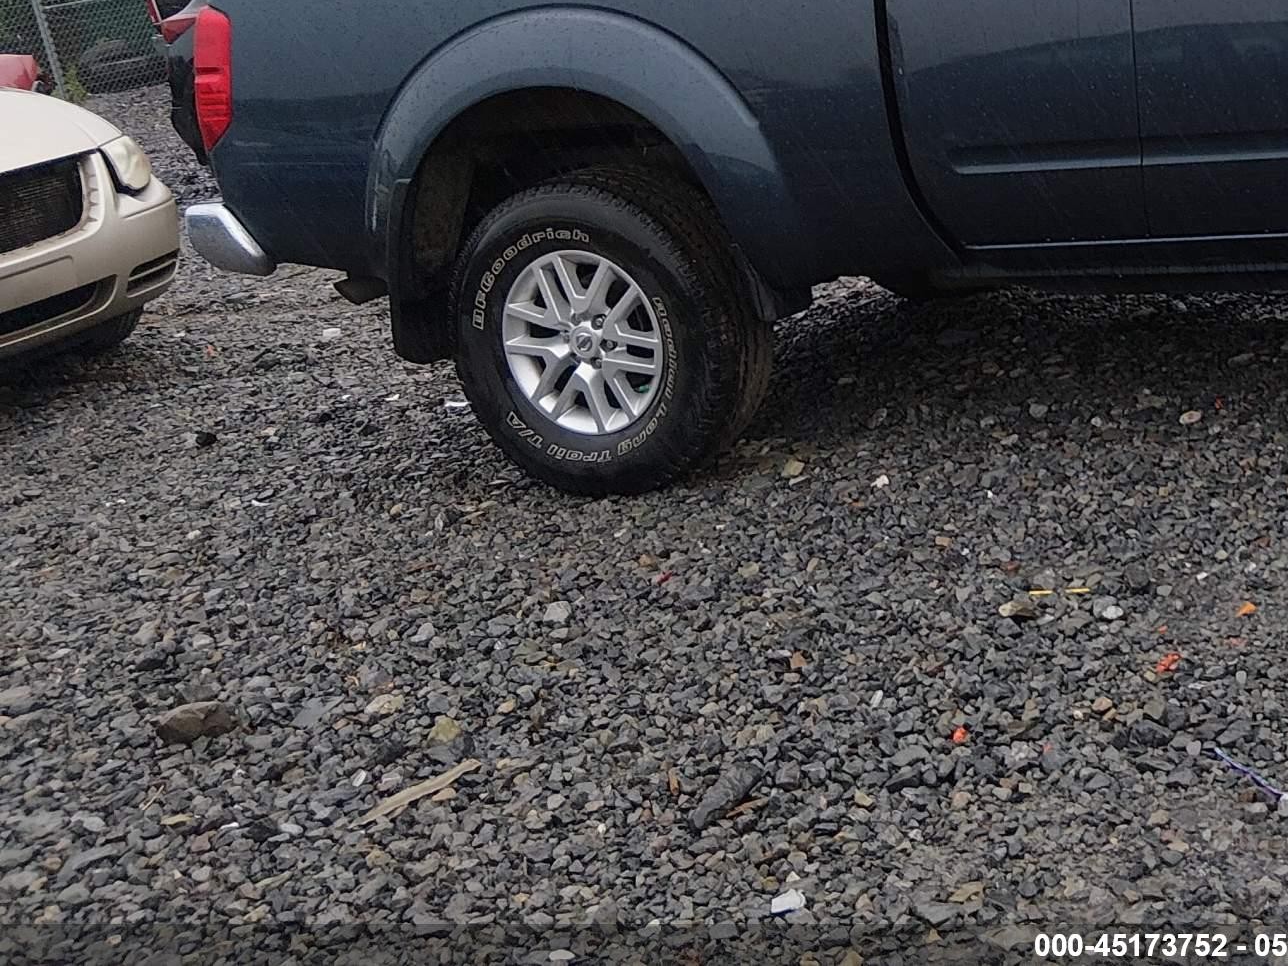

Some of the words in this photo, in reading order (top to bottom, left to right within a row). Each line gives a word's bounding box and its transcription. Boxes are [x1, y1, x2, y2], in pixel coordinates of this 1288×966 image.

[471, 227, 591, 330] BFGoodrich
[505, 410, 544, 448] T/A
[617, 403, 669, 455] Long
[546, 444, 614, 463] Trail
